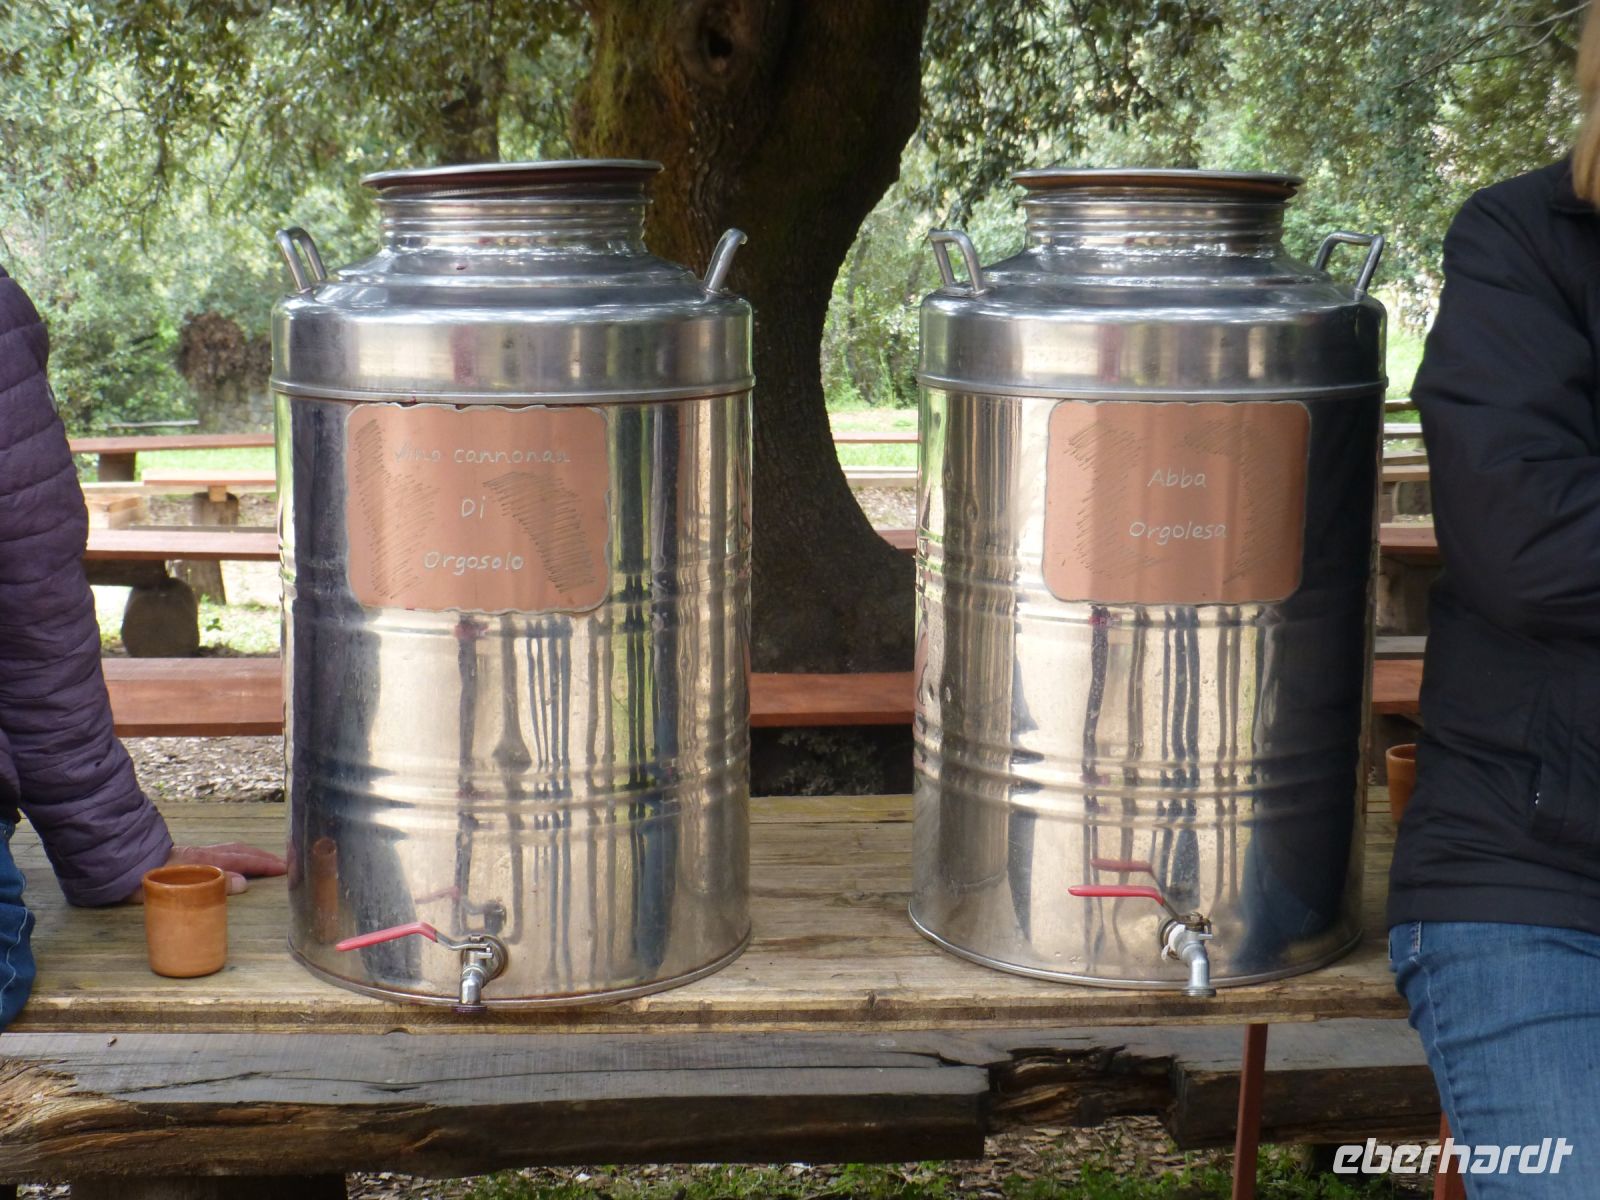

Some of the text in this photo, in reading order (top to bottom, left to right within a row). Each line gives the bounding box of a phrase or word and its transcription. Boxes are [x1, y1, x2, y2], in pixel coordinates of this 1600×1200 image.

[1147, 467, 1207, 488] Abba
[460, 496, 486, 520] Di
[1129, 521, 1228, 546] Orgolesa
[423, 551, 524, 576] Orgosolo
